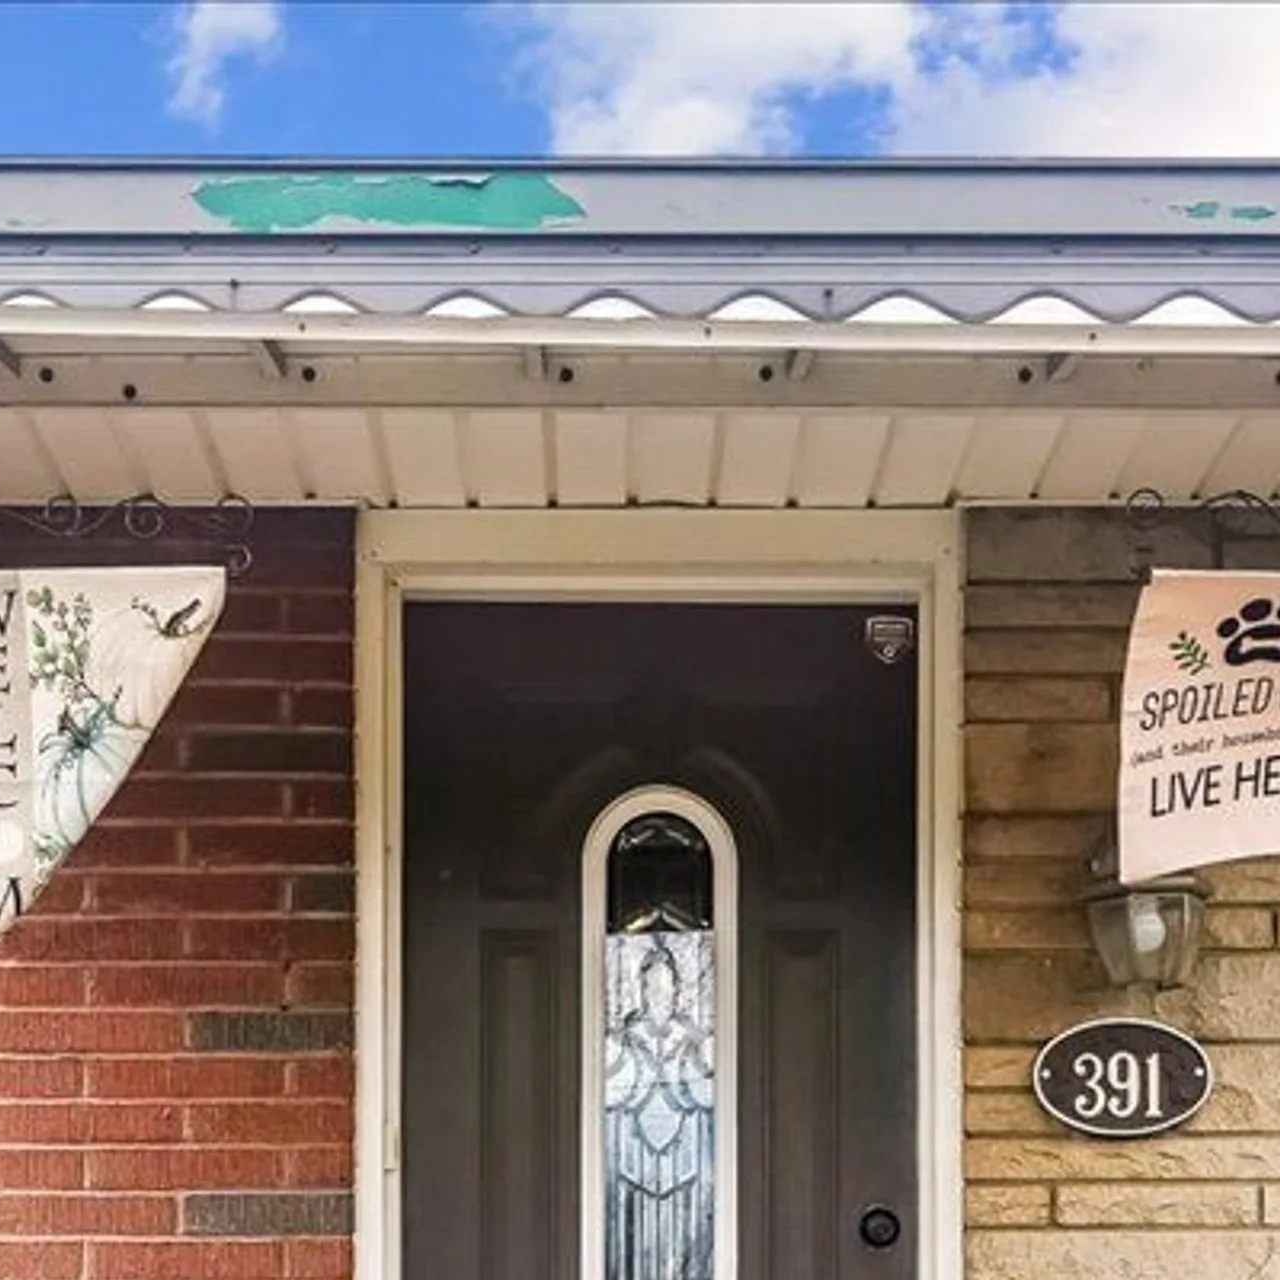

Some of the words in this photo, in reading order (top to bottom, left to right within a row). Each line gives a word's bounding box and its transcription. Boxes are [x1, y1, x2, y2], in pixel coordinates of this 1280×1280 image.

[1139, 676, 1274, 732] SPOILED
[1150, 765, 1222, 818] LIVE
[1072, 1050, 1164, 1120] 391
